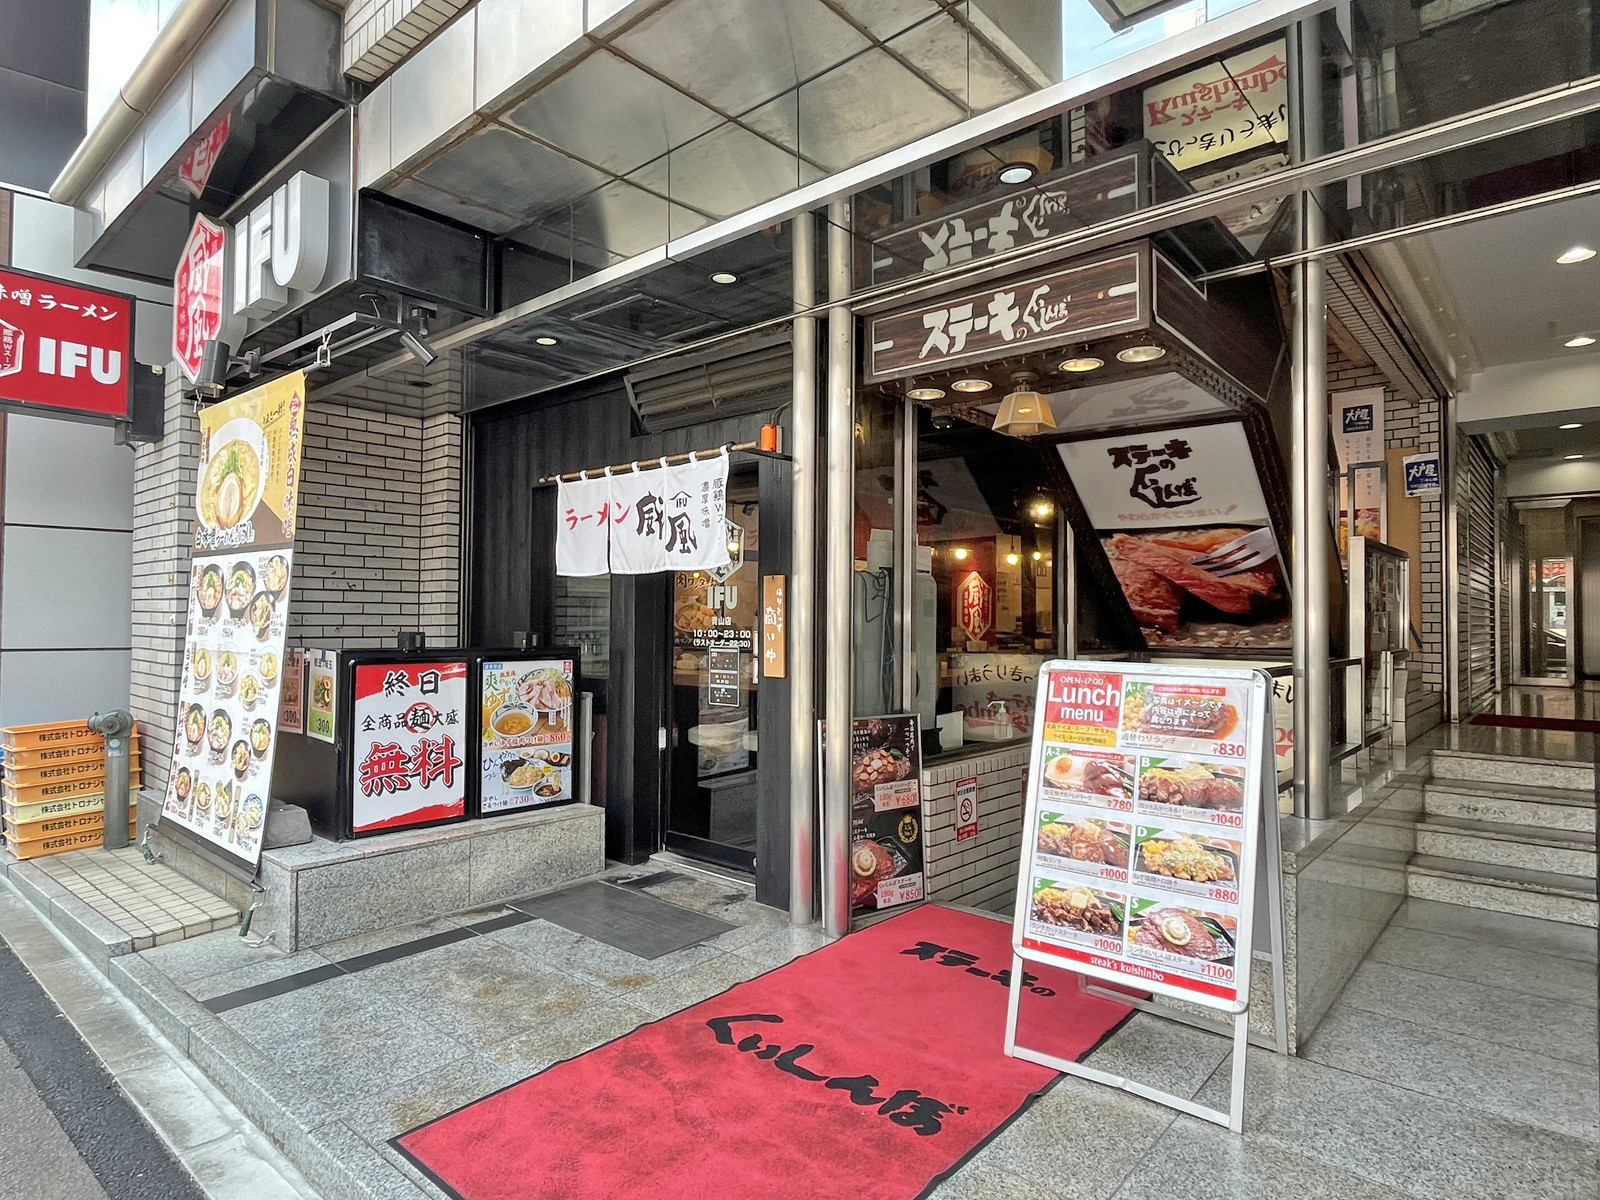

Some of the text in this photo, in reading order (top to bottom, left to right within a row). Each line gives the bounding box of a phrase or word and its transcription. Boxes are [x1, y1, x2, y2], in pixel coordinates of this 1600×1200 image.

[233, 171, 326, 316] IFU
[39, 337, 121, 385] IFU
[676, 497, 688, 508] IFU
[565, 501, 632, 531] ラーメン
[707, 585, 738, 610] IFU
[383, 668, 441, 698] 終日
[1048, 680, 1121, 707] Lunch
[1152, 696, 1223, 709] 写真はイメージです
[1060, 706, 1104, 722] menu
[39, 725, 104, 742] 株式会社トロナジ
[358, 734, 463, 798] 無料
[1141, 757, 1151, 767] B
[1040, 811, 1050, 822] C
[42, 832, 104, 850] 株式会社トロナジ
[1137, 827, 1148, 838] D
[1034, 878, 1042, 888] E
[1131, 897, 1140, 909] S
[1090, 956, 1118, 971] steak's
[1120, 962, 1165, 981] kuishinbo
[706, 1013, 970, 1136] くいしんぼ
